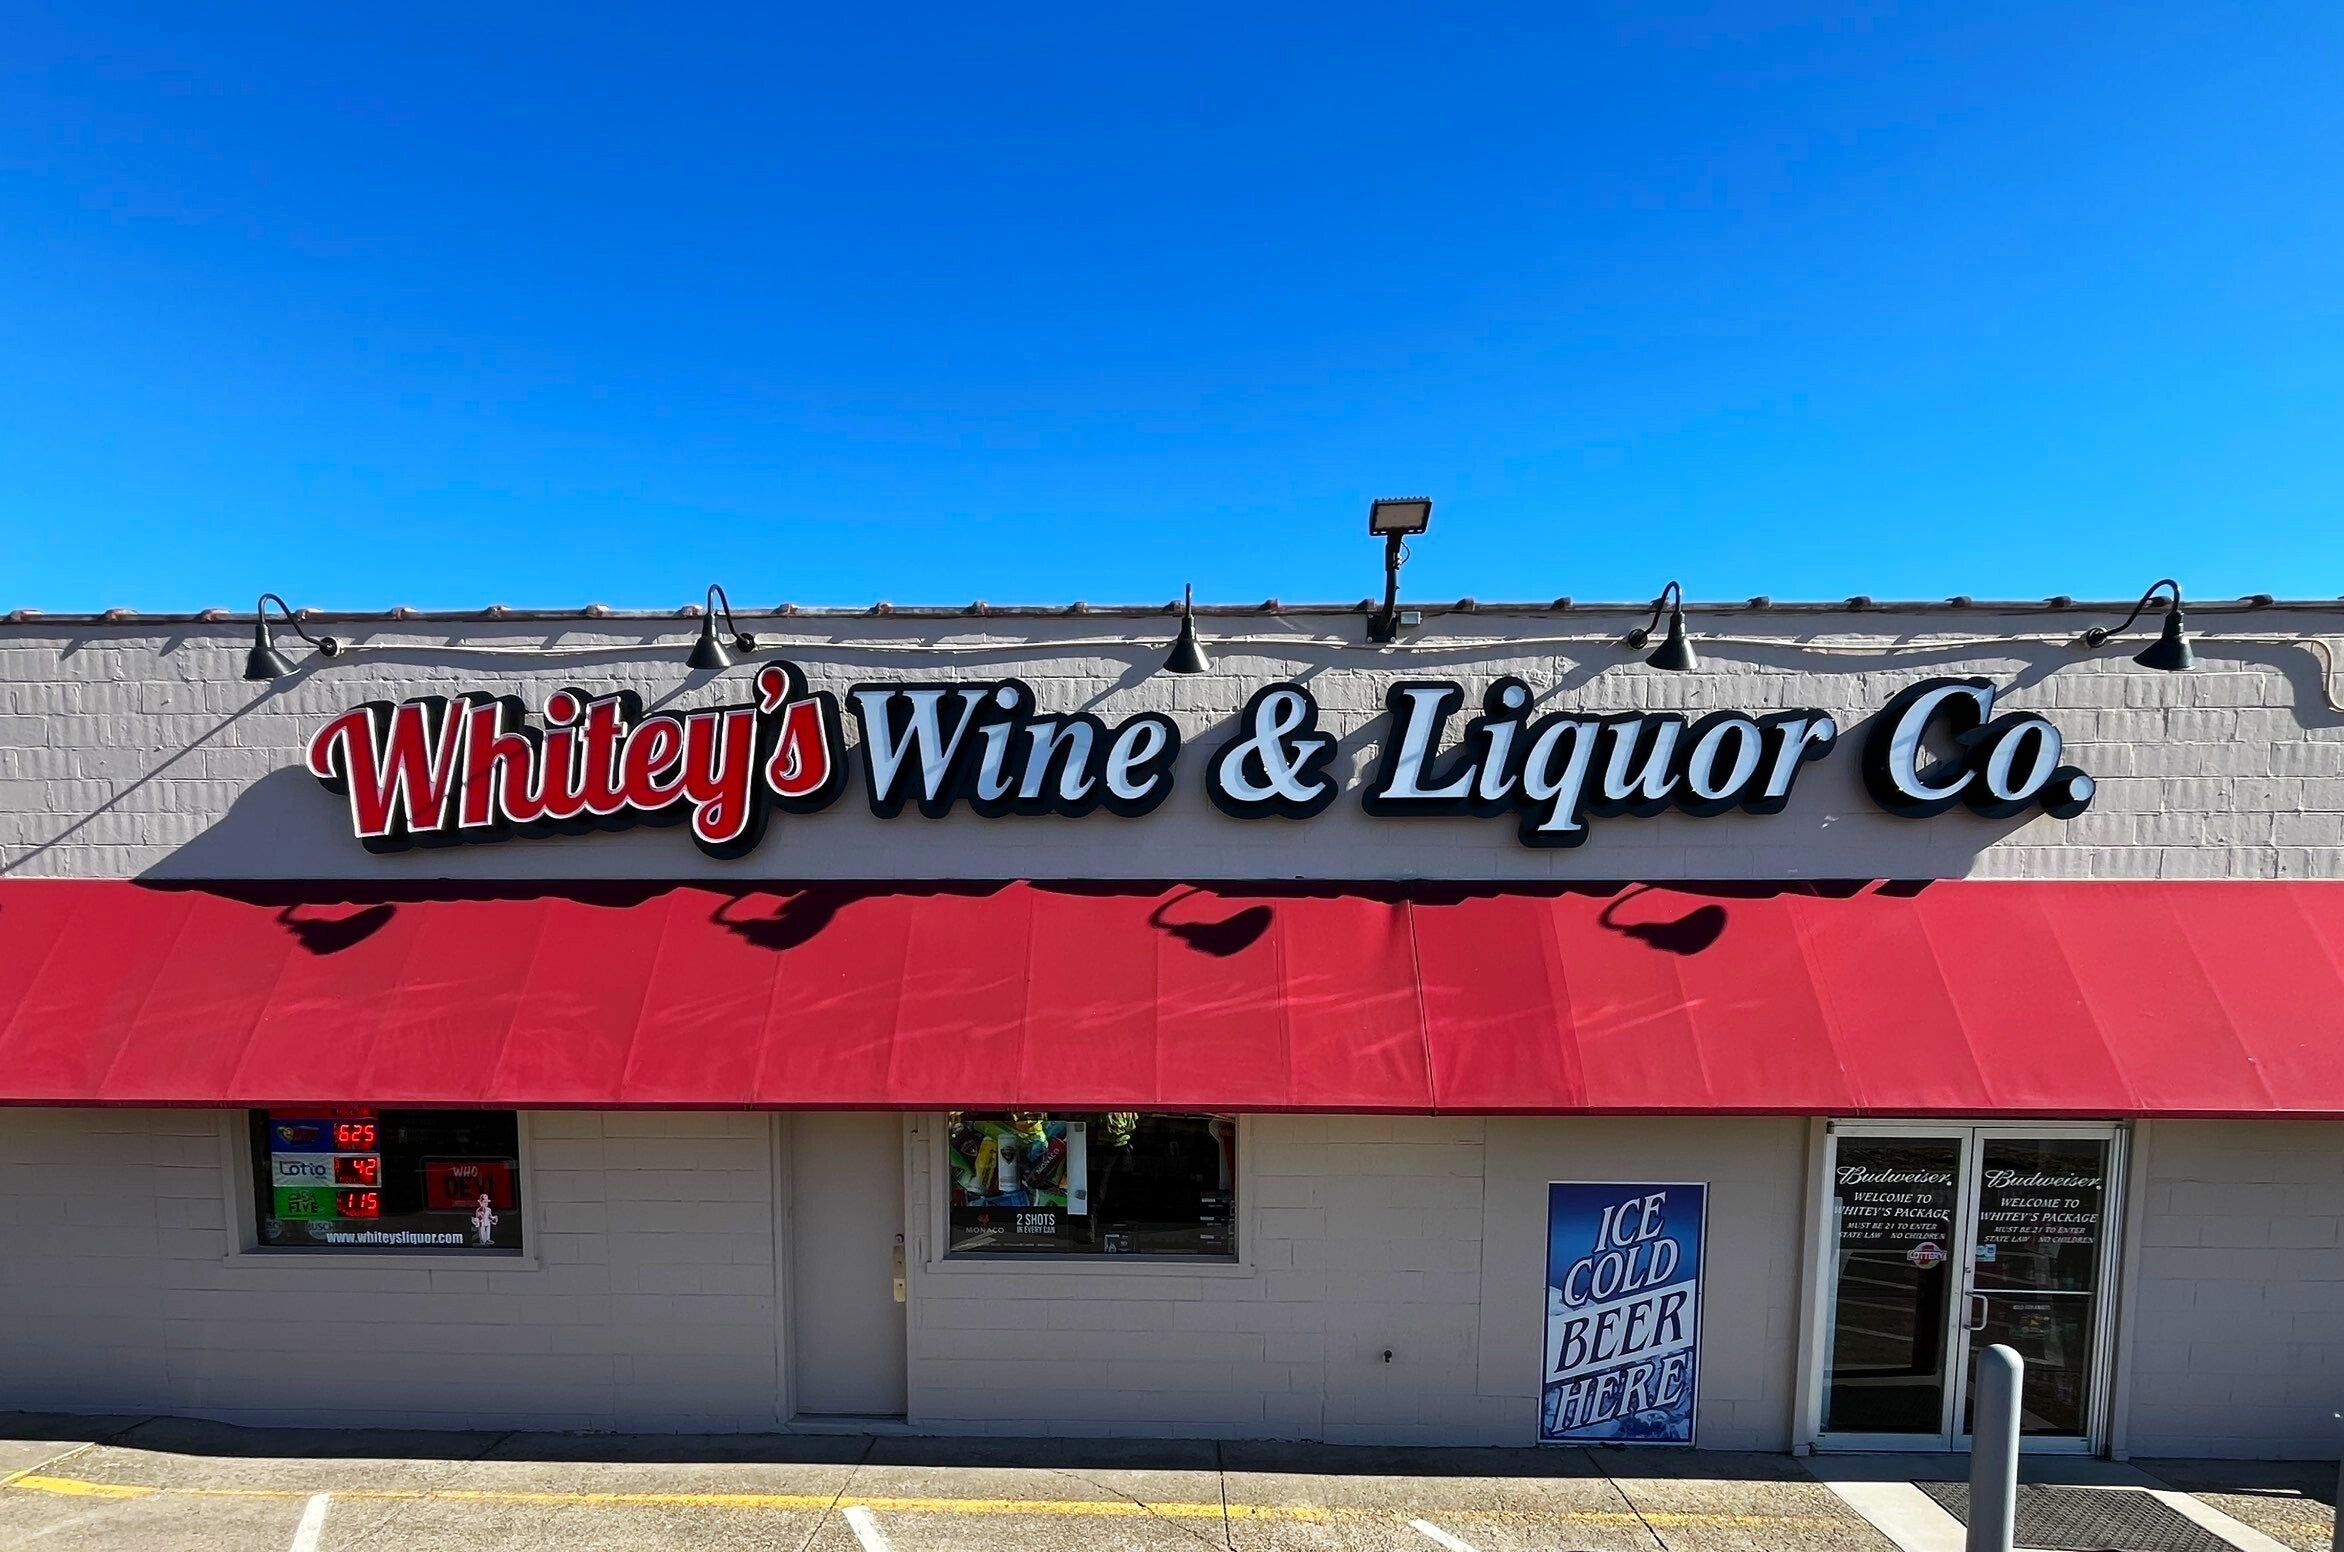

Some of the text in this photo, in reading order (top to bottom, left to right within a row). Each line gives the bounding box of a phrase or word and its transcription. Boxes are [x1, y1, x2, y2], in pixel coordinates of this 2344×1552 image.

[309, 665, 2096, 843] Whitey's Wine & Liquor Co.
[339, 1124, 375, 1142] 625
[353, 1158, 376, 1176] 42
[452, 1166, 478, 1178] WHO
[348, 1193, 377, 1209] 115
[1854, 1192, 1932, 1204] WELCOME TO
[2001, 1197, 2080, 1208] WELCOME TO
[1834, 1206, 1951, 1219] WHITEY'S PACKAGE
[1979, 1212, 2098, 1223] WHITEY'S PACKAGE
[1016, 1214, 1055, 1225] 2 SHOTS
[1594, 1191, 1667, 1254] ICE
[965, 1226, 1005, 1234] MONACO
[1016, 1226, 1056, 1234] IN EVERY CAN
[1847, 1222, 1871, 1230] MUST
[1872, 1222, 1883, 1230] BE
[1885, 1222, 1895, 1230] 21
[2031, 1226, 2042, 1234] 21
[326, 1230, 464, 1245] www.whiteysliquor.com
[1839, 1231, 1862, 1239] STATE
[1908, 1250, 1947, 1260] LOTTERY
[1564, 1238, 1679, 1308] COLD
[1554, 1291, 1688, 1374] BEER
[1551, 1353, 1688, 1433] HERE
